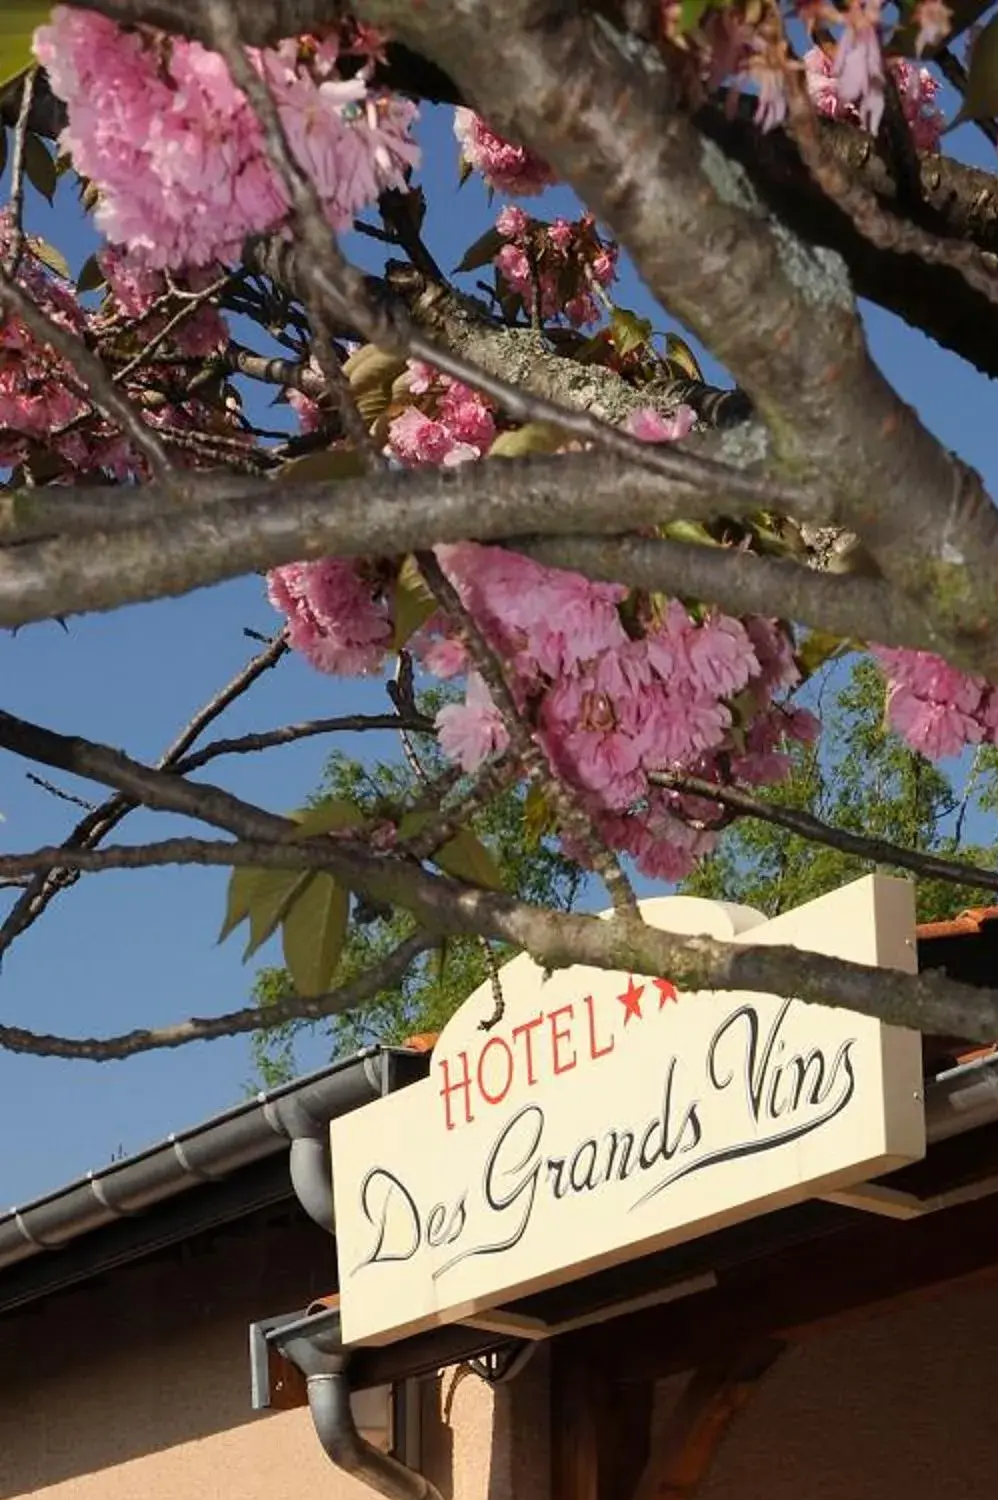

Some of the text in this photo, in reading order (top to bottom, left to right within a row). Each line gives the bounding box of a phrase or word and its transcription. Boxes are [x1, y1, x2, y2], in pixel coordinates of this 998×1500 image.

[349, 996, 859, 1280] Des Grands Vins
[437, 995, 616, 1131] HOTEL
